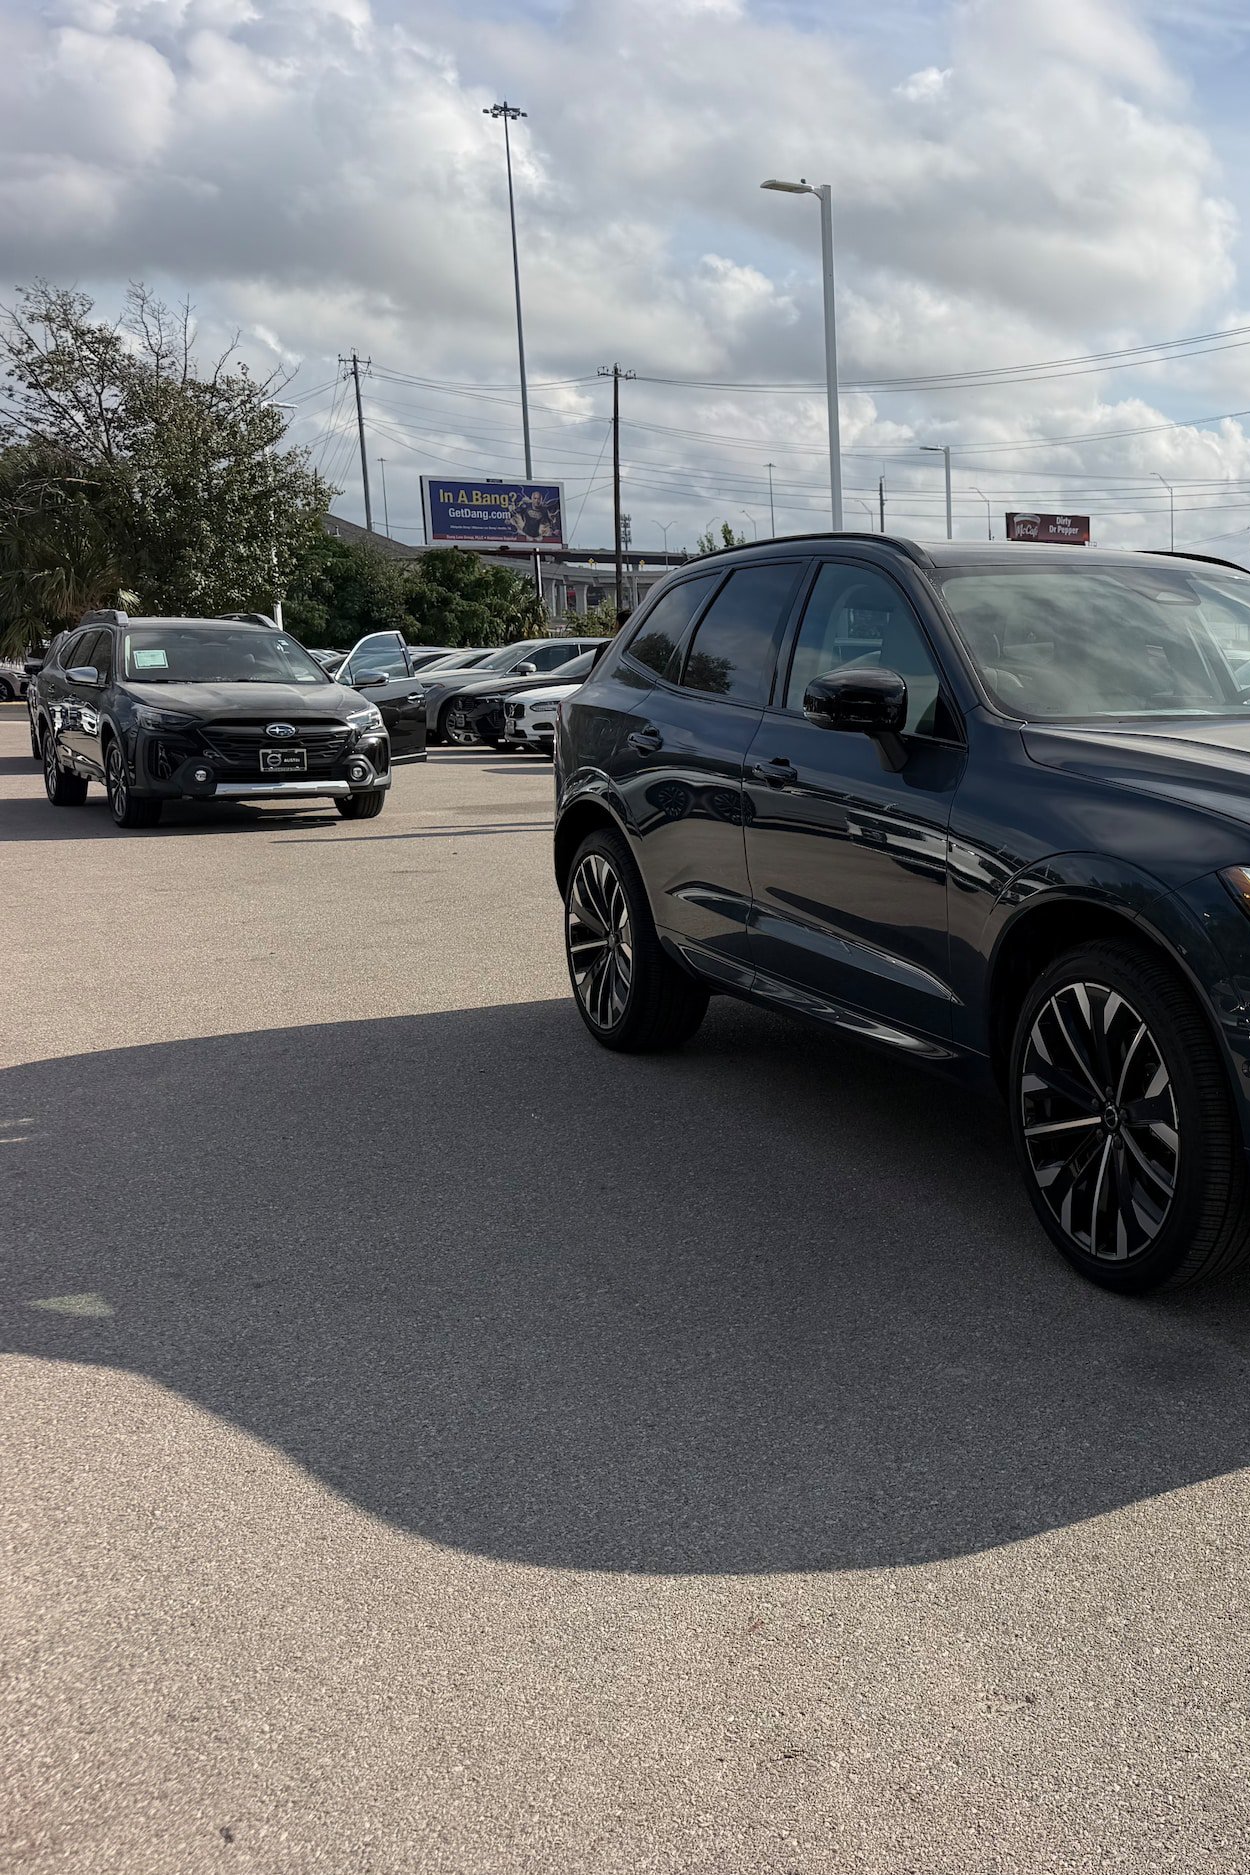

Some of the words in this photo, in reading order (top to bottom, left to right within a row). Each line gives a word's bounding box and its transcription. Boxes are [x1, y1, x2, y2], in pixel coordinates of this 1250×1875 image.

[439, 489, 453, 503] In
[457, 489, 469, 504] A
[472, 491, 517, 509] Bang?
[448, 508, 511, 520] GetDang.com
[1056, 516, 1072, 527] Dirty
[1057, 526, 1079, 536] Pepper
